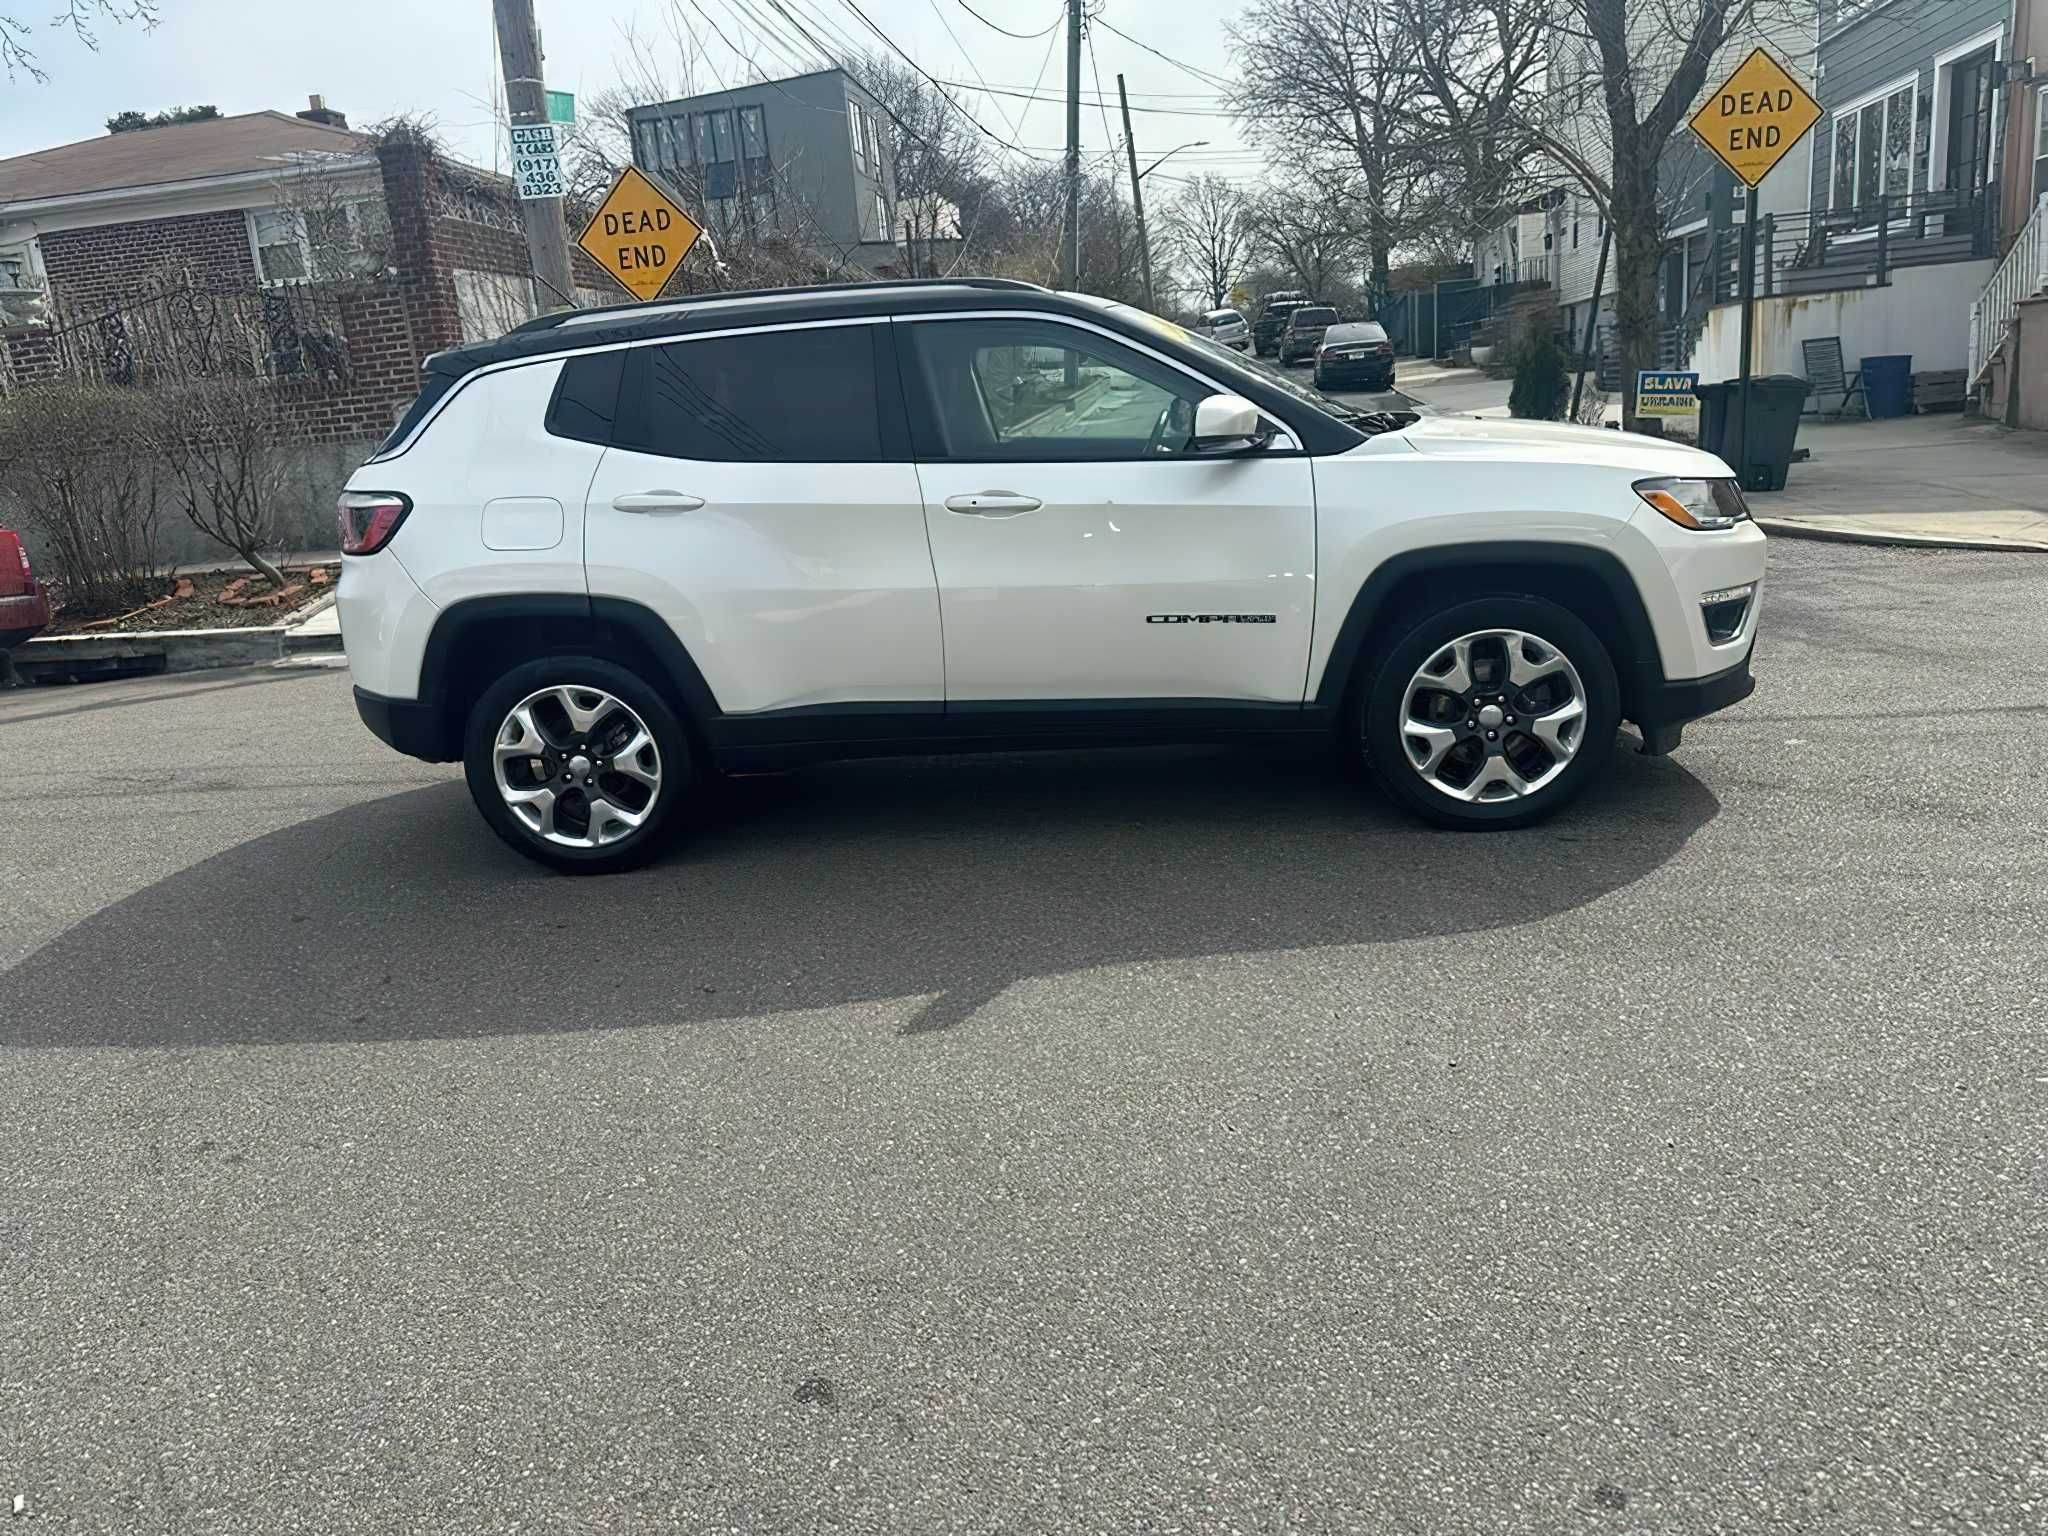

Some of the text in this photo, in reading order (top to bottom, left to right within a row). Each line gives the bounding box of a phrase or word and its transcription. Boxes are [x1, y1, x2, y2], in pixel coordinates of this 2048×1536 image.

[1721, 89, 1793, 117] DEAD
[513, 129, 553, 142] CASH
[1729, 125, 1781, 151] END
[526, 143, 554, 154] CARS
[517, 157, 559, 172] (917)
[526, 171, 556, 183] 436
[522, 183, 563, 196] 8323
[604, 208, 671, 236] DEAD
[618, 245, 666, 270] END
[1644, 376, 1692, 390] SLAVA
[1146, 614, 1277, 624] COMPA
